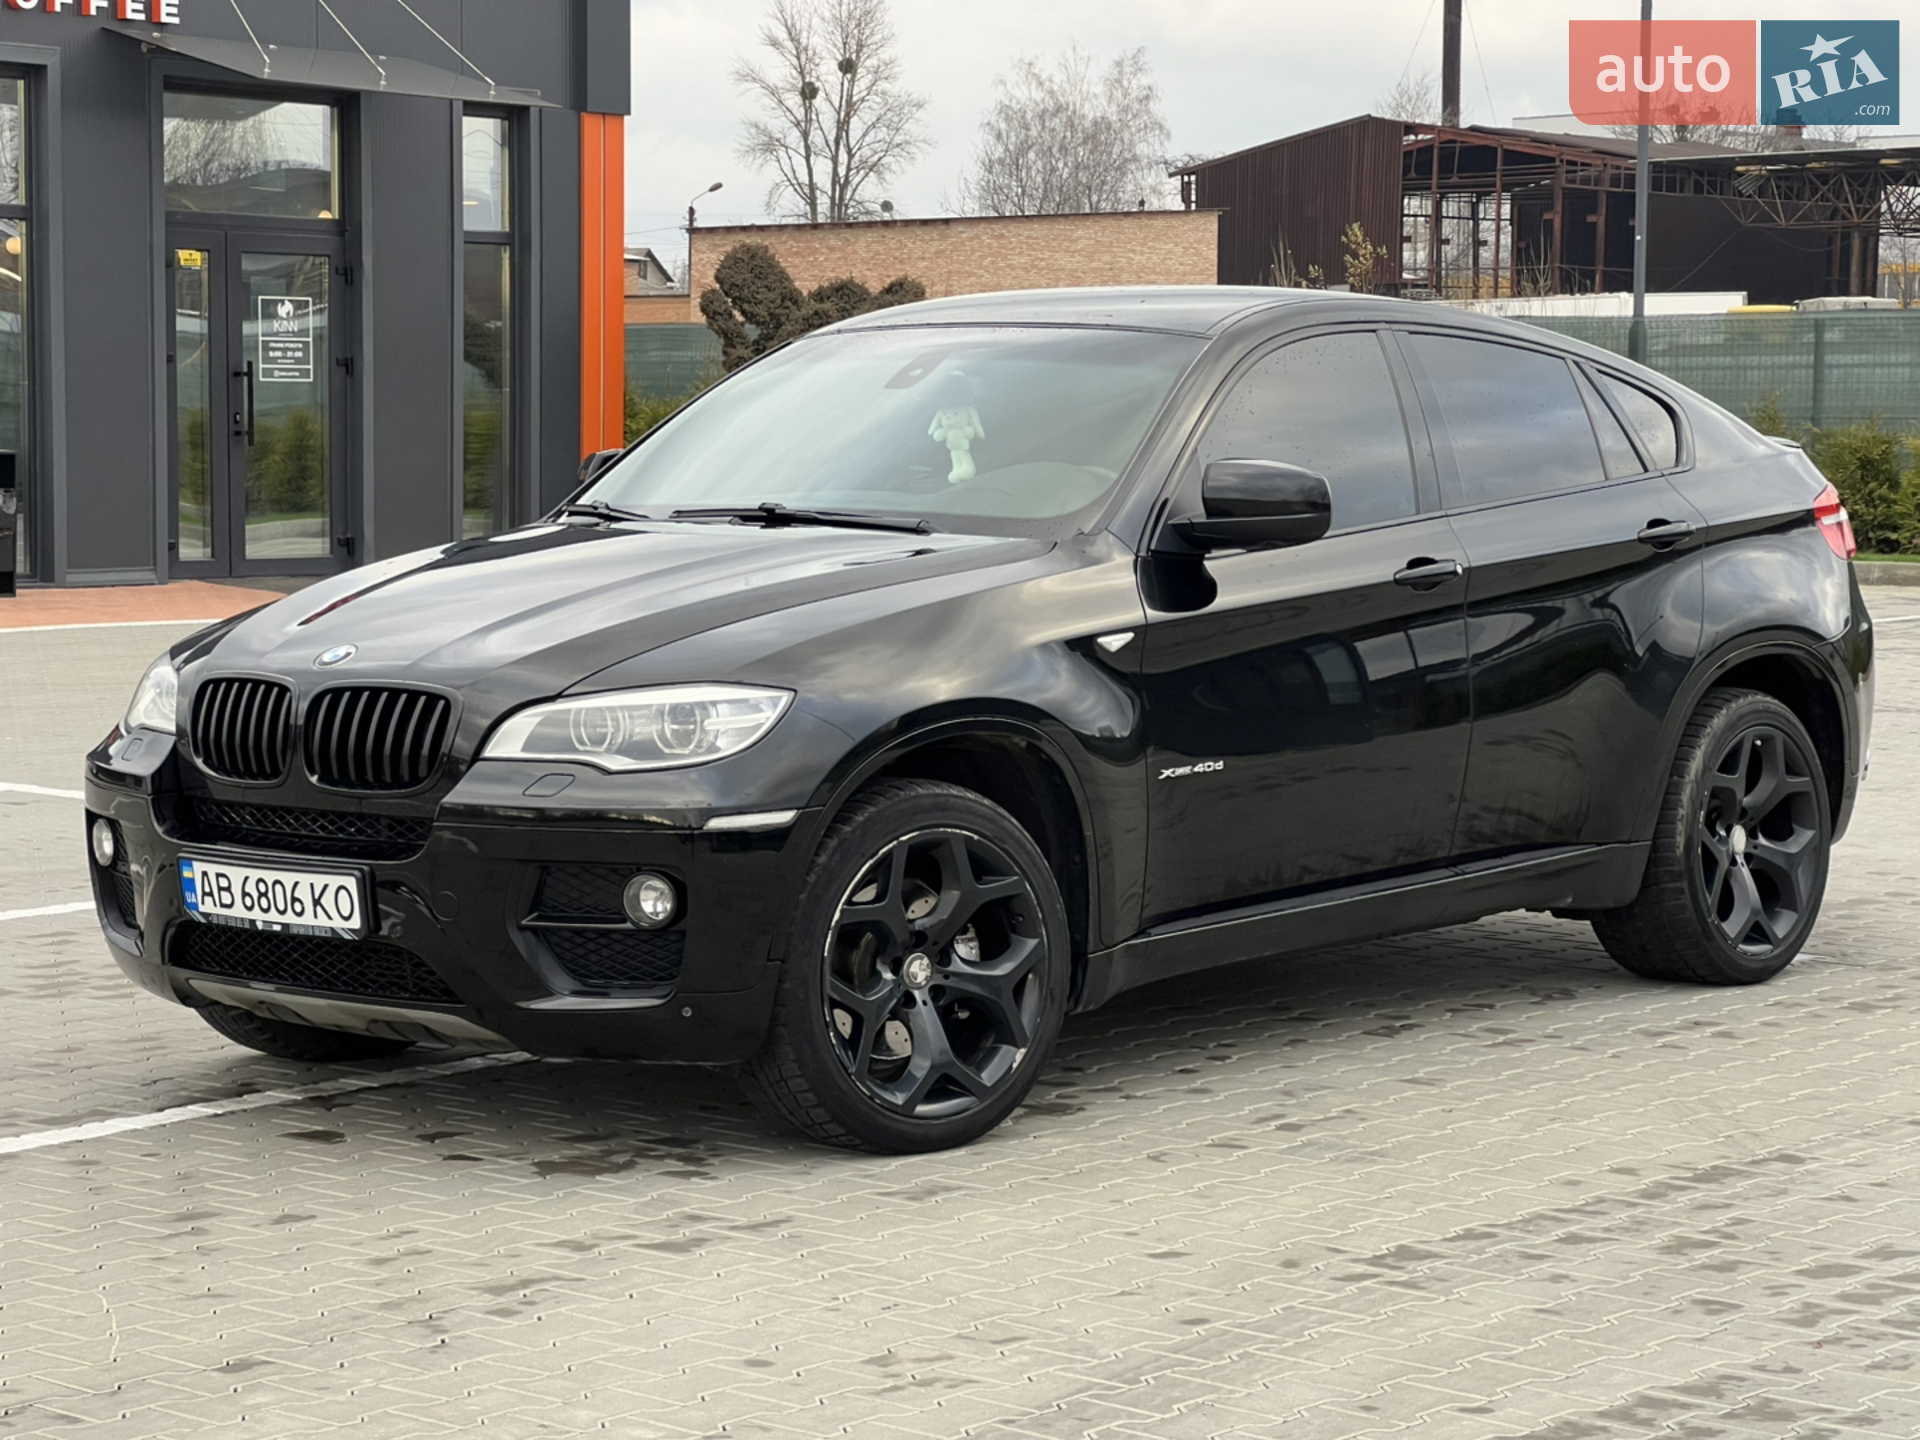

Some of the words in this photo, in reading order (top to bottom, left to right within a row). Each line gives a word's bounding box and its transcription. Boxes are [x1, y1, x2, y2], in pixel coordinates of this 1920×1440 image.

[186, 891, 198, 903] UA
[200, 870, 235, 909] AB
[240, 875, 305, 918] 6806
[309, 882, 355, 922] KO
